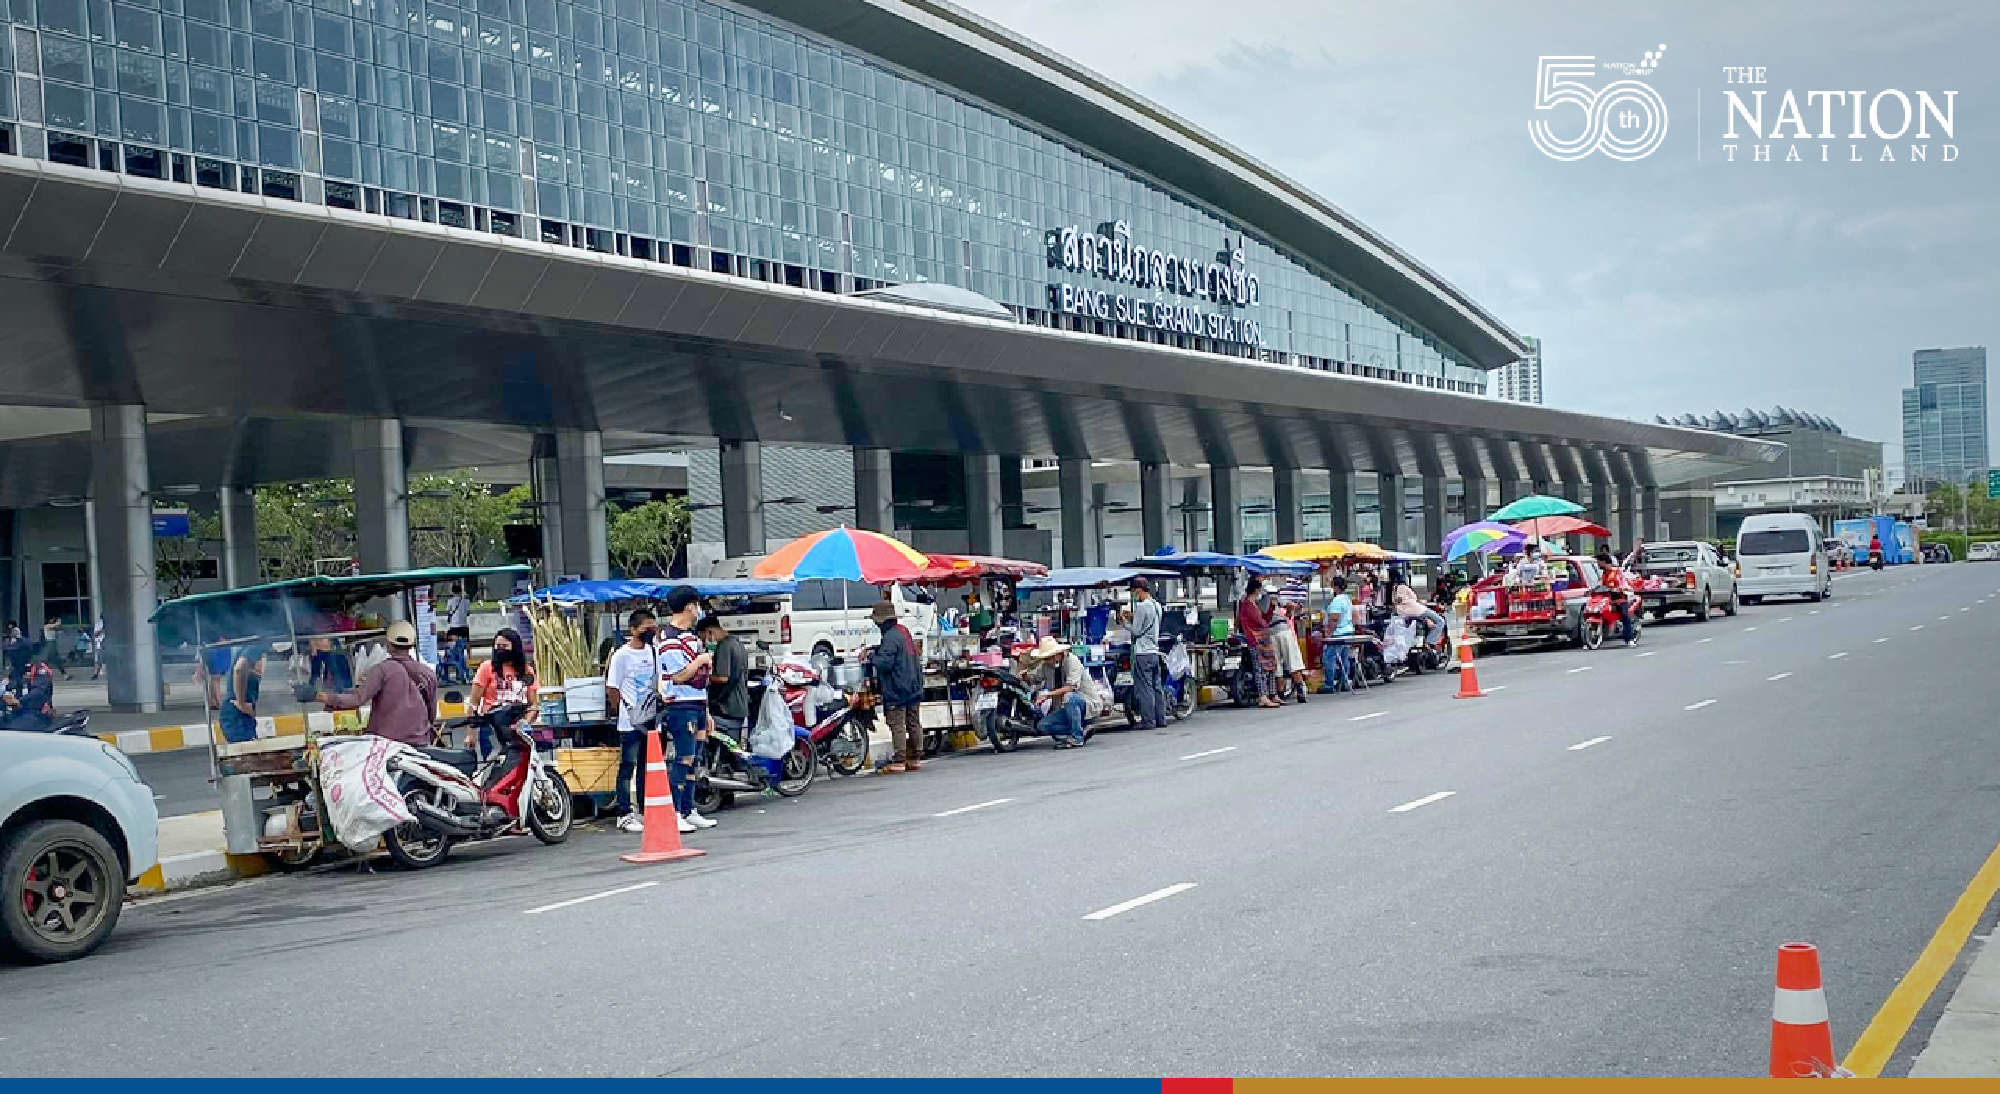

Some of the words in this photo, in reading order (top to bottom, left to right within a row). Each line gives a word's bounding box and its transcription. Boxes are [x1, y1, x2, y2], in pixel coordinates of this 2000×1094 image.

[1061, 221, 1260, 307] สถานีกลางบางซื่อ
[1063, 283, 1109, 319] BANG
[1116, 294, 1147, 325] SUE
[1155, 302, 1203, 335] GRAND
[1208, 313, 1260, 345] STATION
